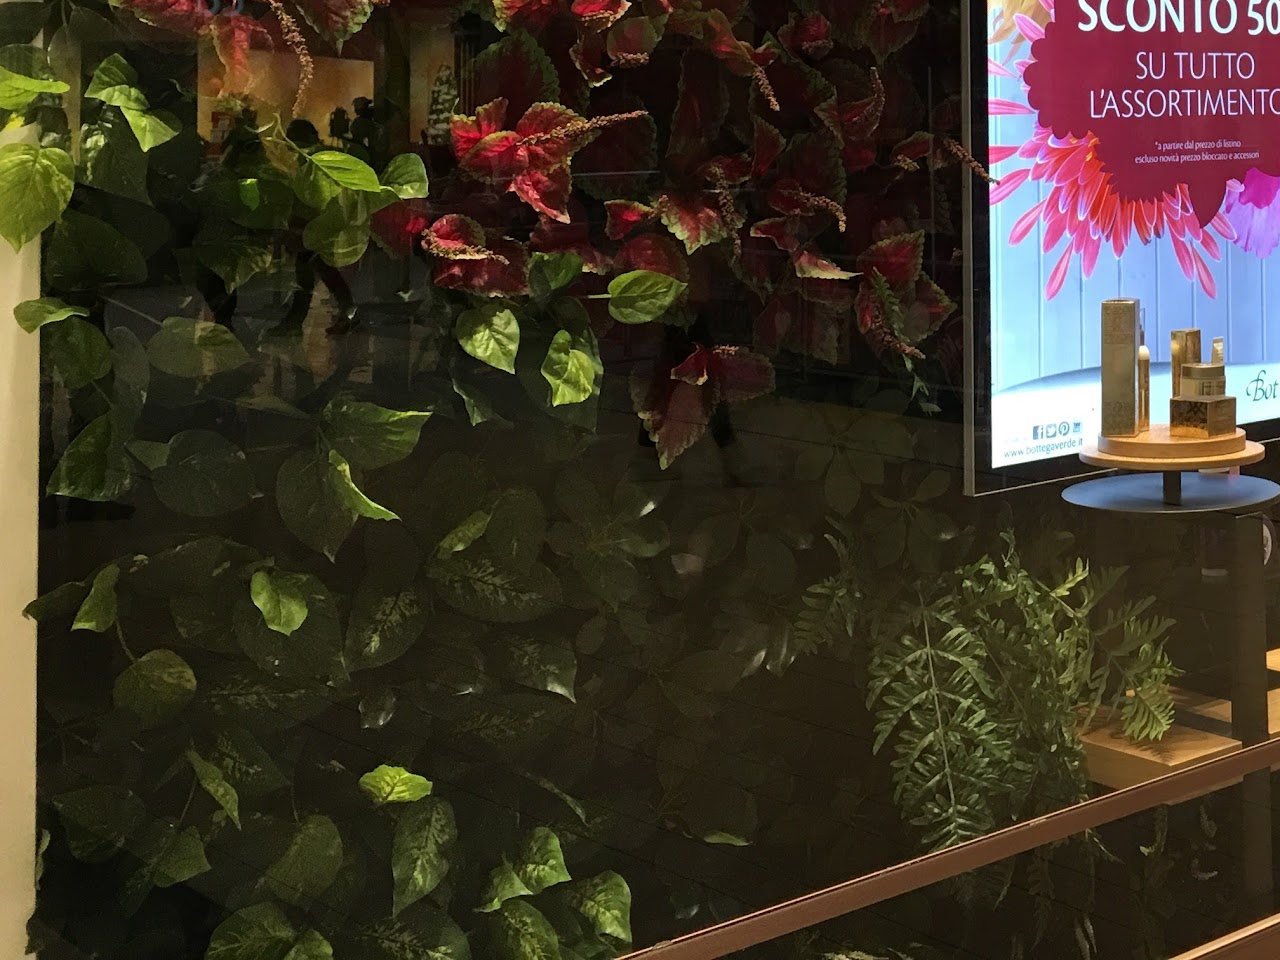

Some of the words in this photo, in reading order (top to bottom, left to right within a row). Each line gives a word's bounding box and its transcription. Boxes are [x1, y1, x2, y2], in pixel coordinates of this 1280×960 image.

[1135, 51, 1166, 80] SU
[1174, 51, 1256, 80] TUTTO
[1184, 139, 1194, 149] dal
[1194, 141, 1215, 151] prezzo
[1134, 153, 1159, 164] escluso
[1180, 154, 1201, 164] prezzo
